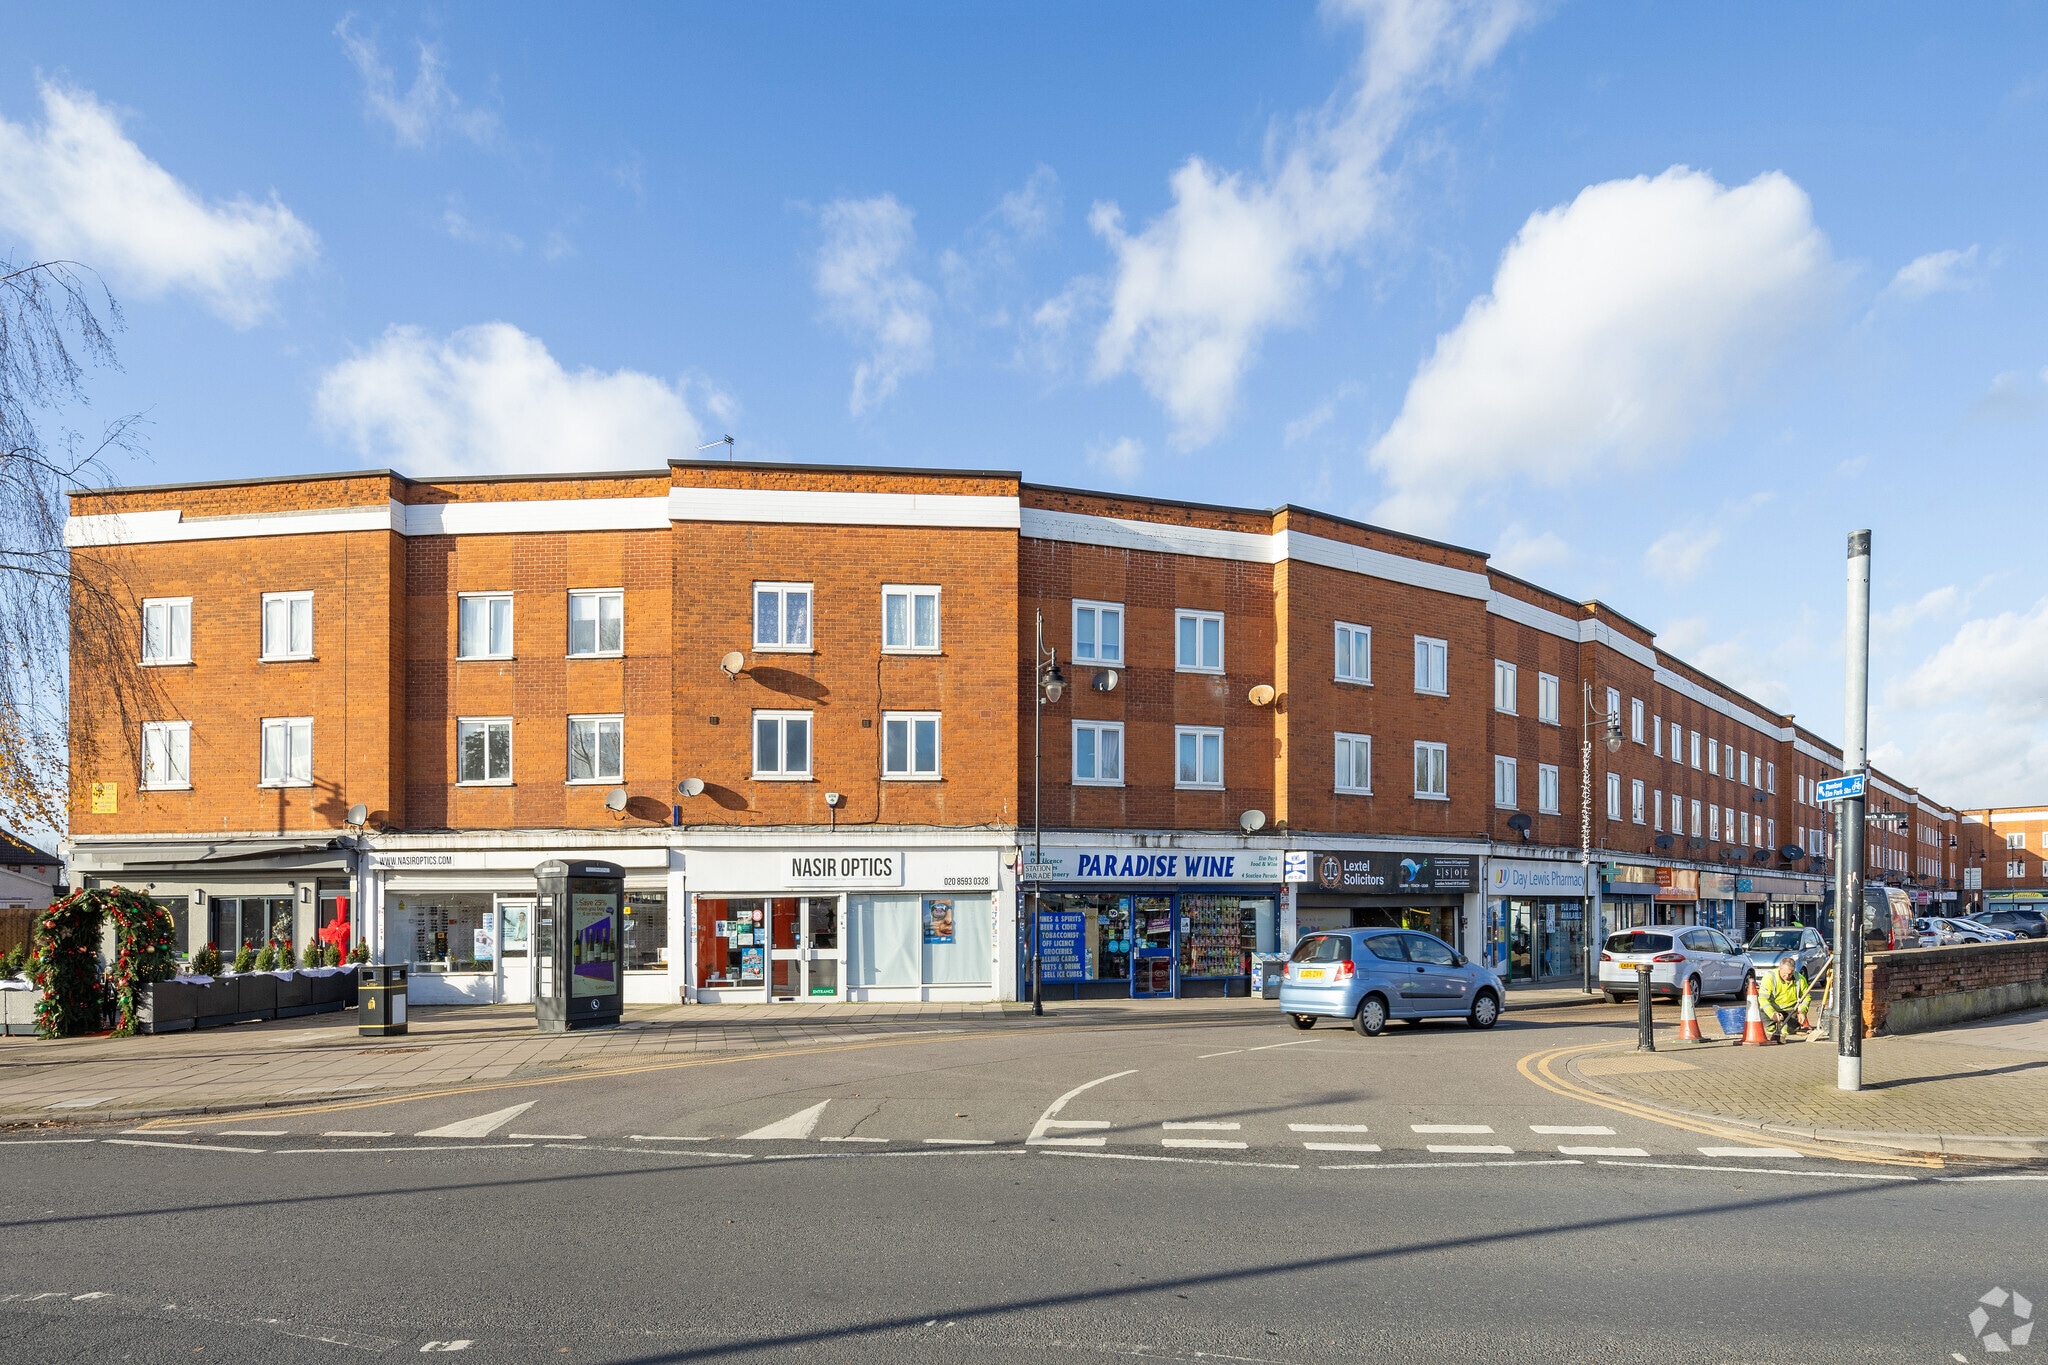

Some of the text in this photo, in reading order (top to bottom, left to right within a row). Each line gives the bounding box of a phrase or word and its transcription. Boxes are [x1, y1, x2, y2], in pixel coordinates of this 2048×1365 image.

[1833, 788, 1843, 796] Park
[379, 856, 452, 866] WWW.NASIROPTICS.COM
[1077, 854, 1236, 878] PARADISE WINE
[1344, 860, 1371, 872] Lextel
[792, 858, 892, 877] NASIR OPTICS
[944, 876, 990, 886] 020 8593 0328
[1026, 872, 1051, 880] PARADE
[1344, 873, 1385, 886] Solicitors
[1513, 869, 1585, 890] Day Lewis Pharmacy
[579, 898, 593, 906] Save
[1066, 970, 1083, 978] CUBES
